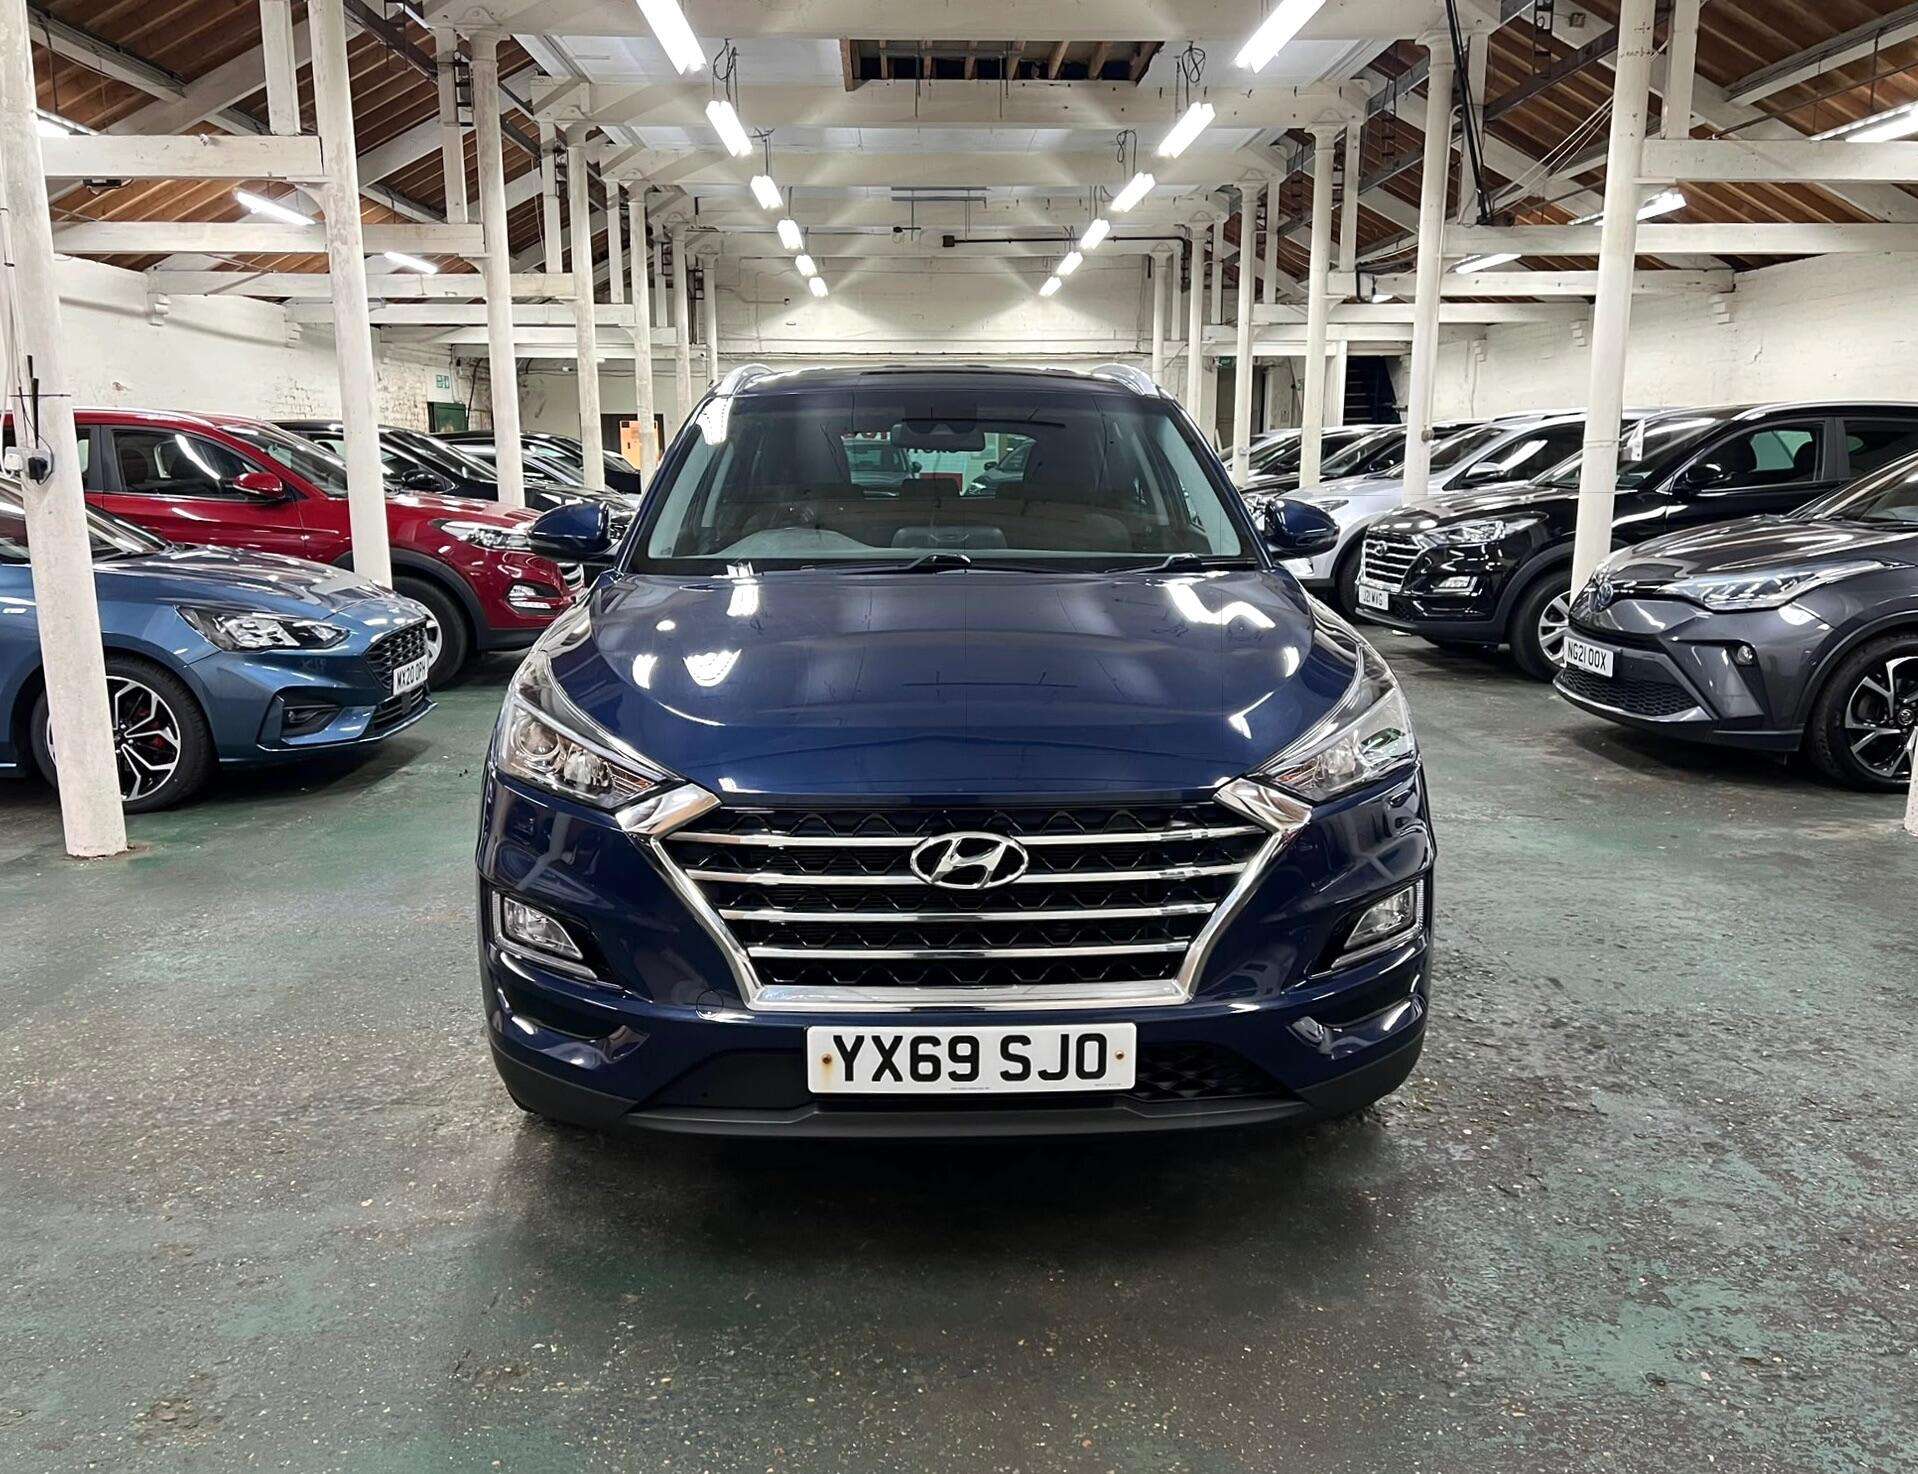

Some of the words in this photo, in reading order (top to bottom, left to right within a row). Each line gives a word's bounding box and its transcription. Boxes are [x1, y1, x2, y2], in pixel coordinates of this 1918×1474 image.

[1567, 641, 1587, 663] NG21
[1588, 649, 1607, 671] OOX
[833, 1034, 980, 1082] YX69
[1000, 1033, 1107, 1082] SJO
